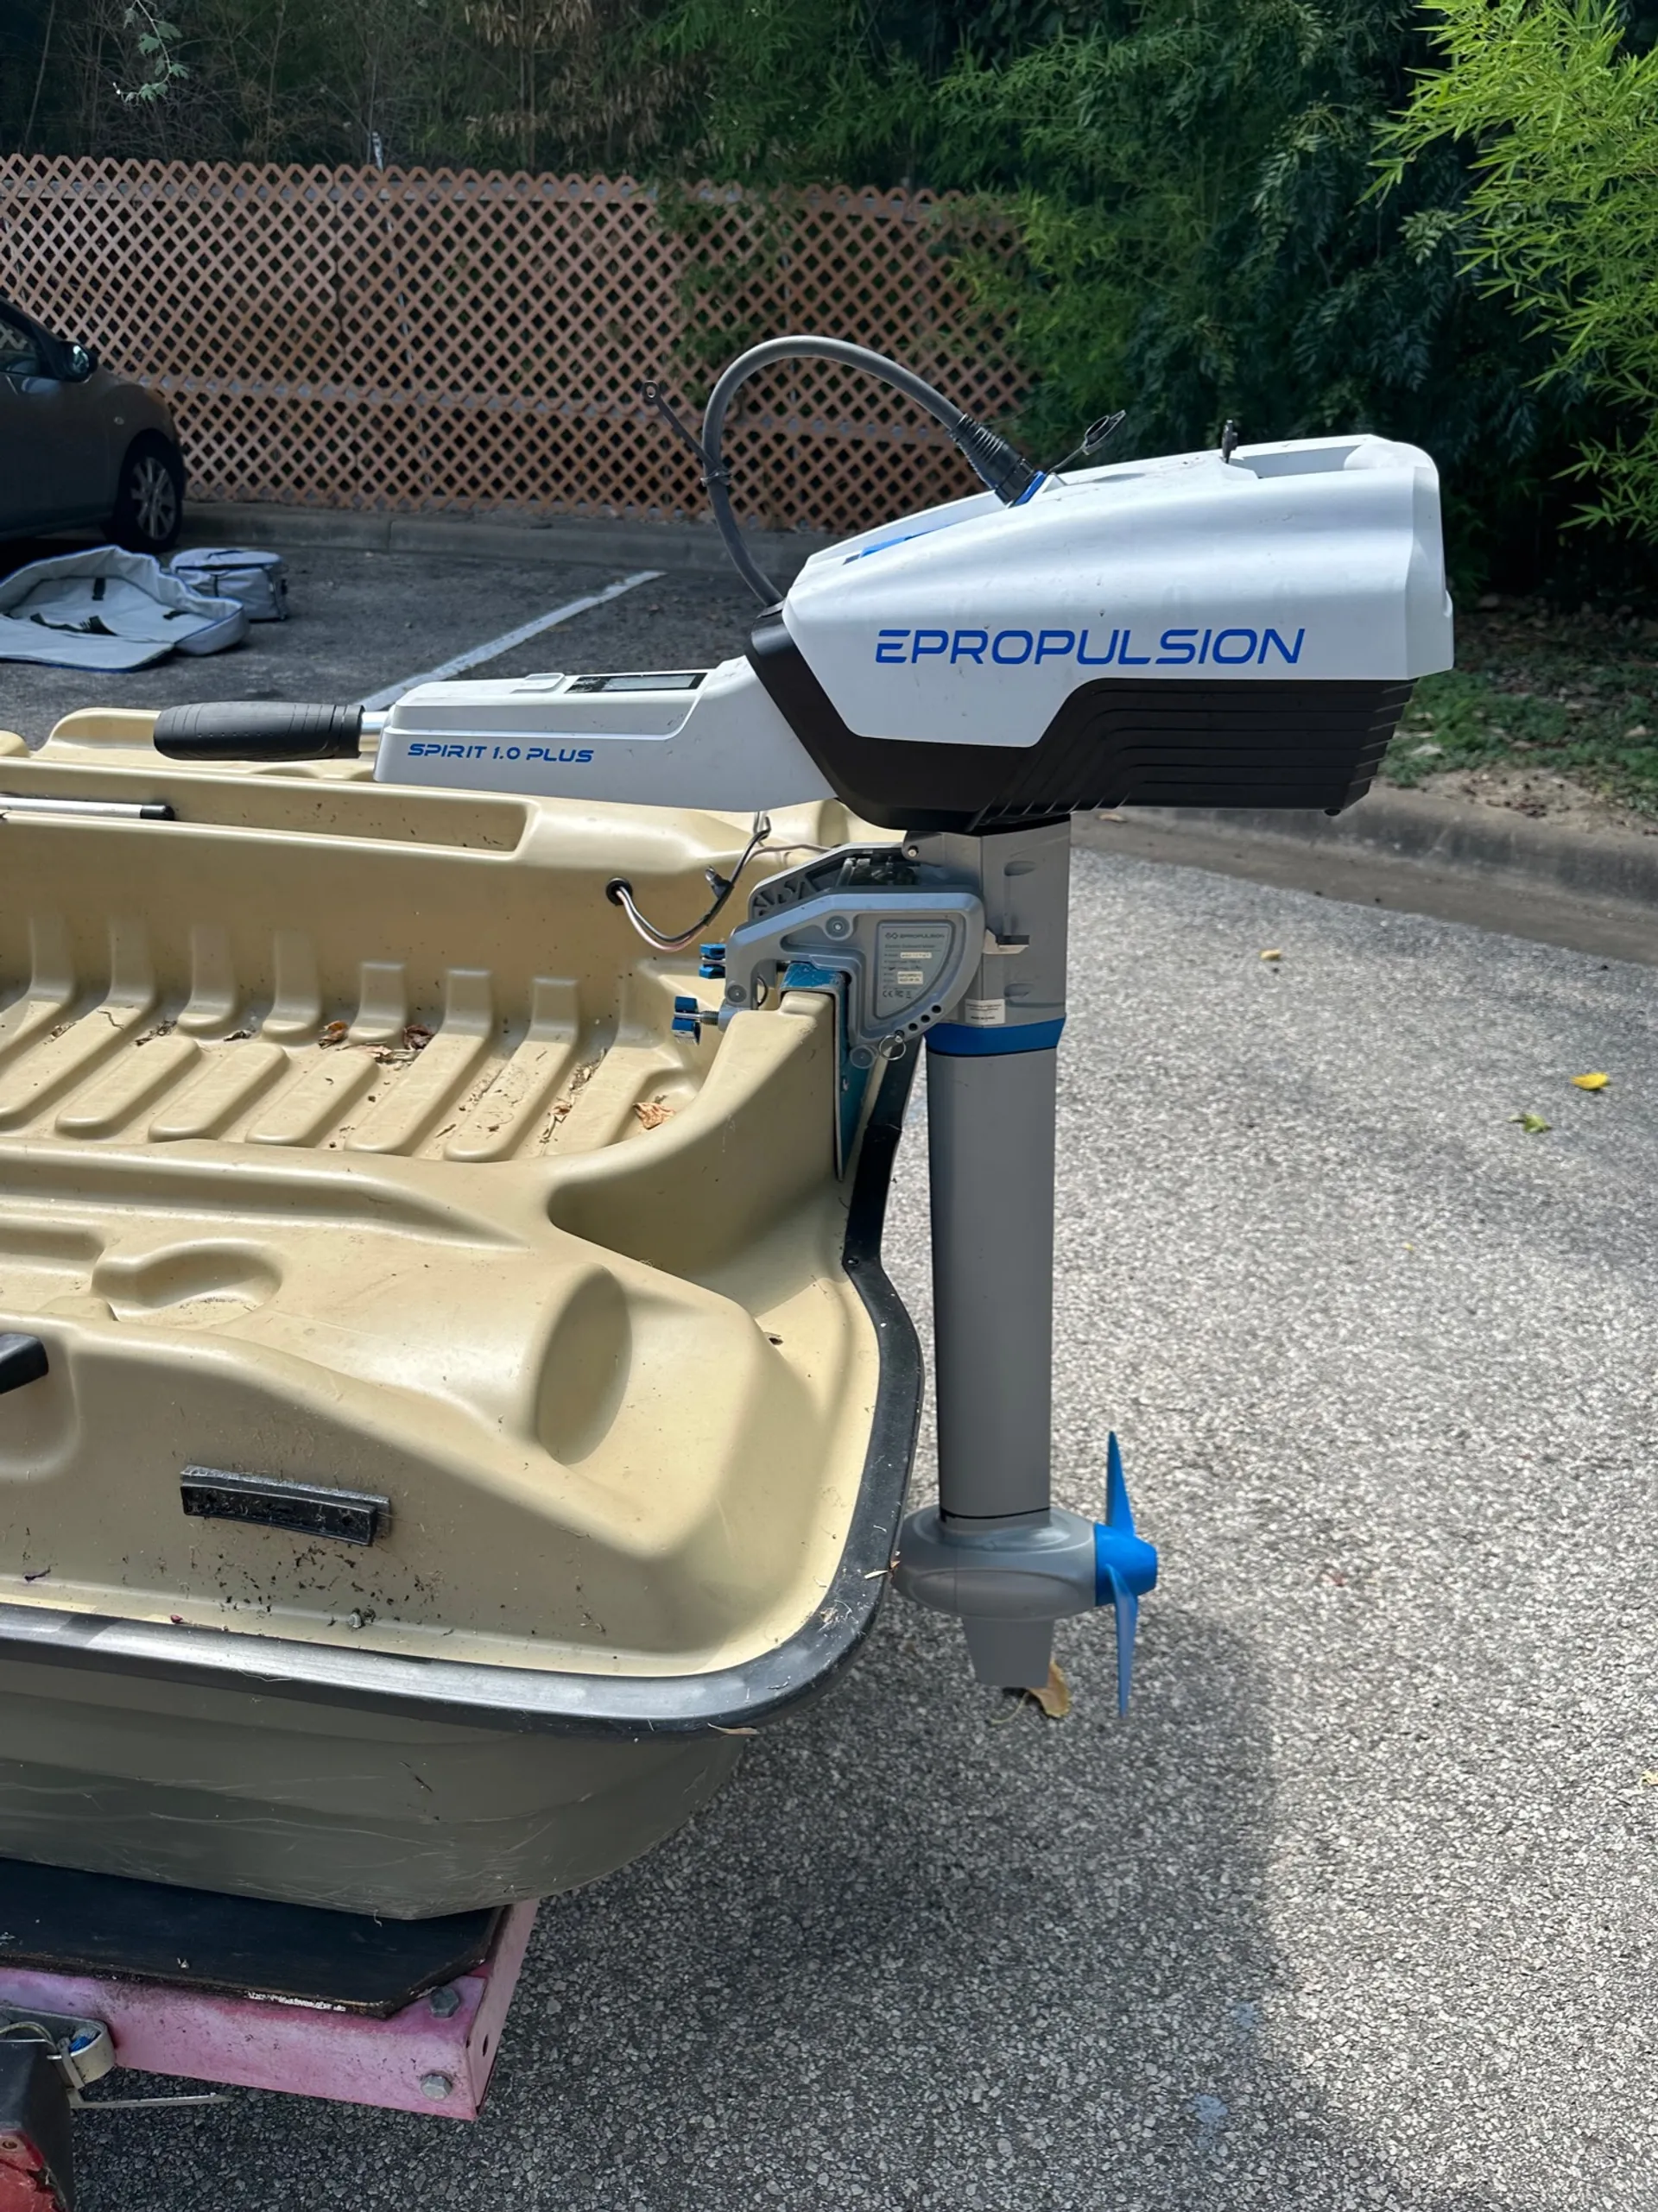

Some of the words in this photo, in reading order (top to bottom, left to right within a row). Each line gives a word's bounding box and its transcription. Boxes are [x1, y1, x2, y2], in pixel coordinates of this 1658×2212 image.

[876, 629, 1305, 664] EPROPULSION
[408, 743, 487, 759] SPIRIT
[492, 747, 521, 761] 1.0
[526, 748, 594, 762] PLUS
